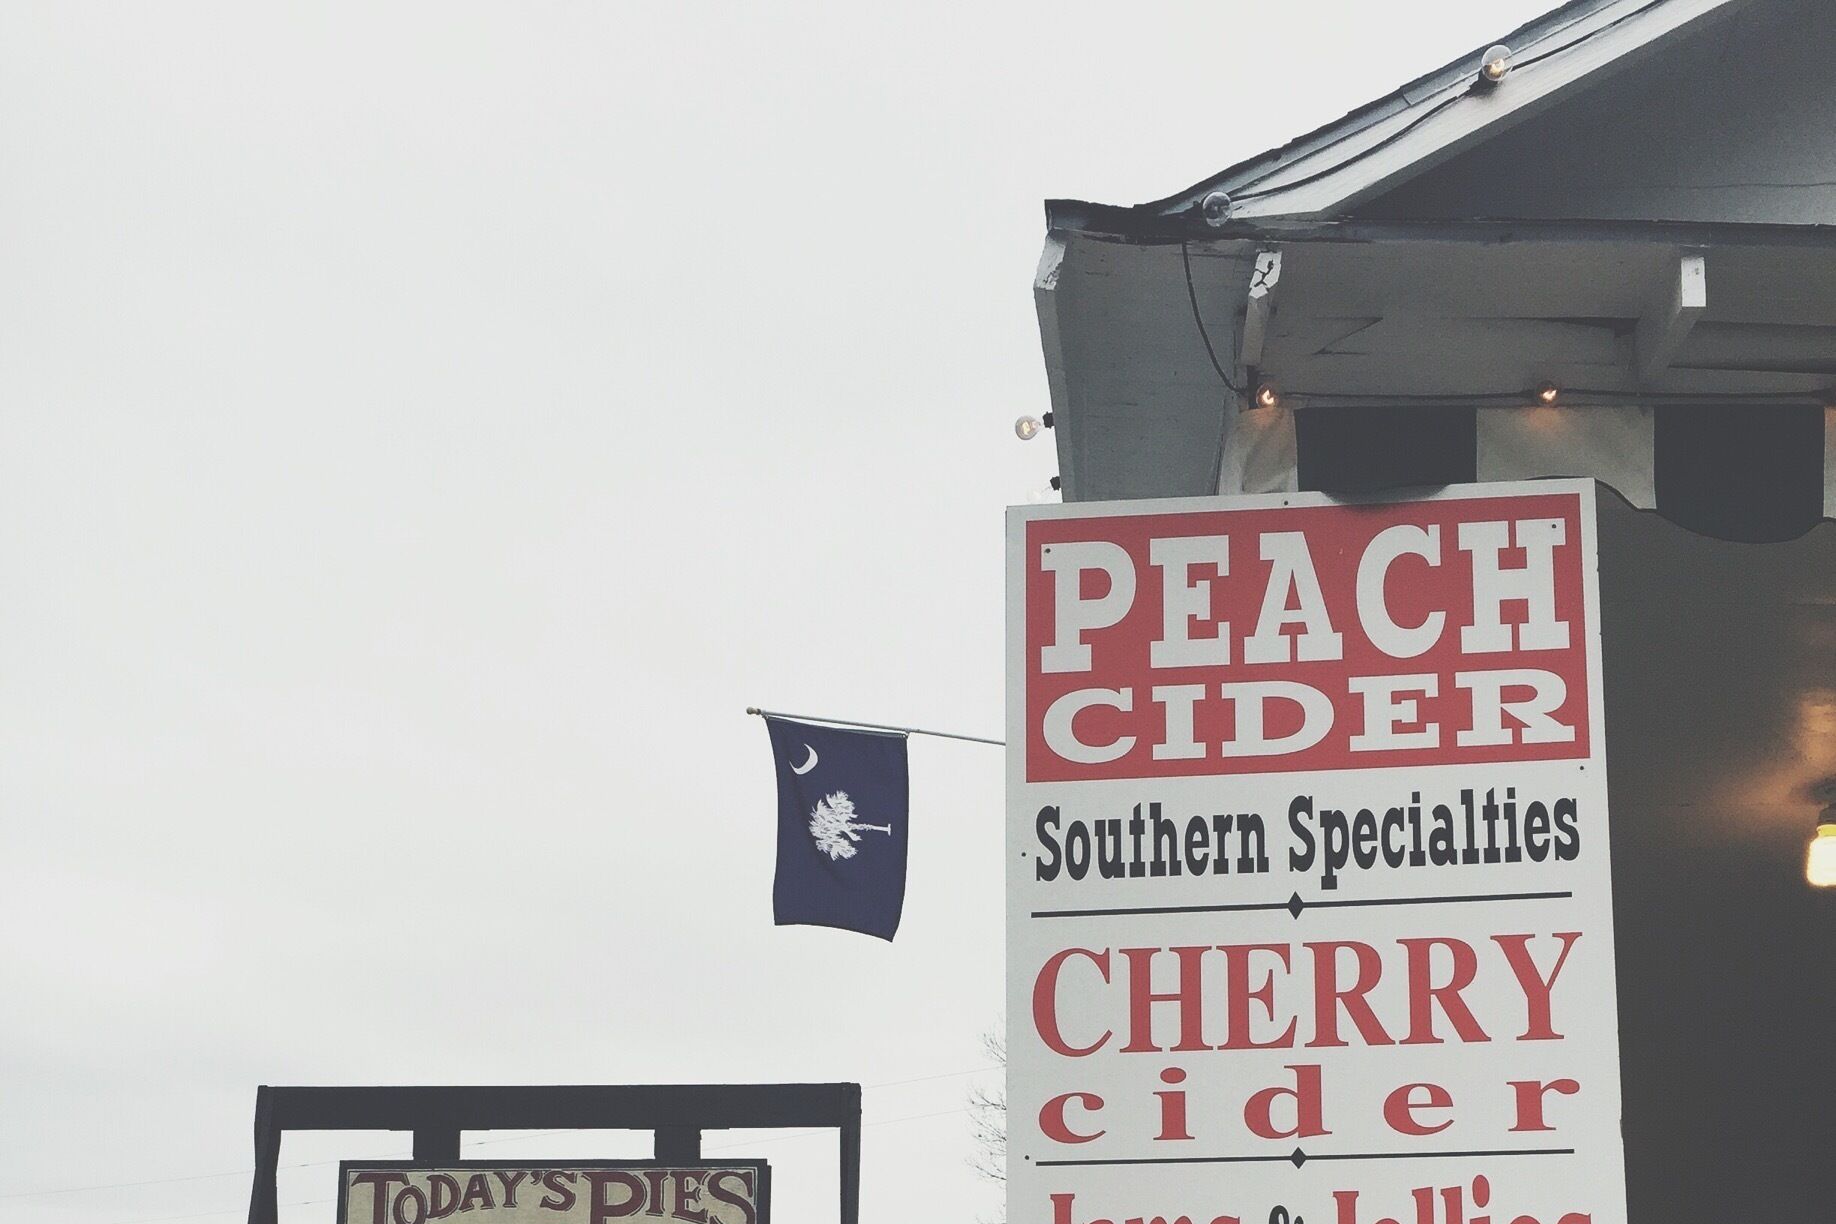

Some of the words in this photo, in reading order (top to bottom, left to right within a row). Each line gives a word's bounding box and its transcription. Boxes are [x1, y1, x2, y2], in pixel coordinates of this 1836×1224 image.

[1041, 518, 1571, 674] PEACH
[1043, 668, 1576, 764] CIDER
[1036, 802, 1269, 882] Southern
[1288, 787, 1581, 890] Specialties
[1032, 932, 1583, 1057] CHERRY
[1038, 1065, 1581, 1144] cider
